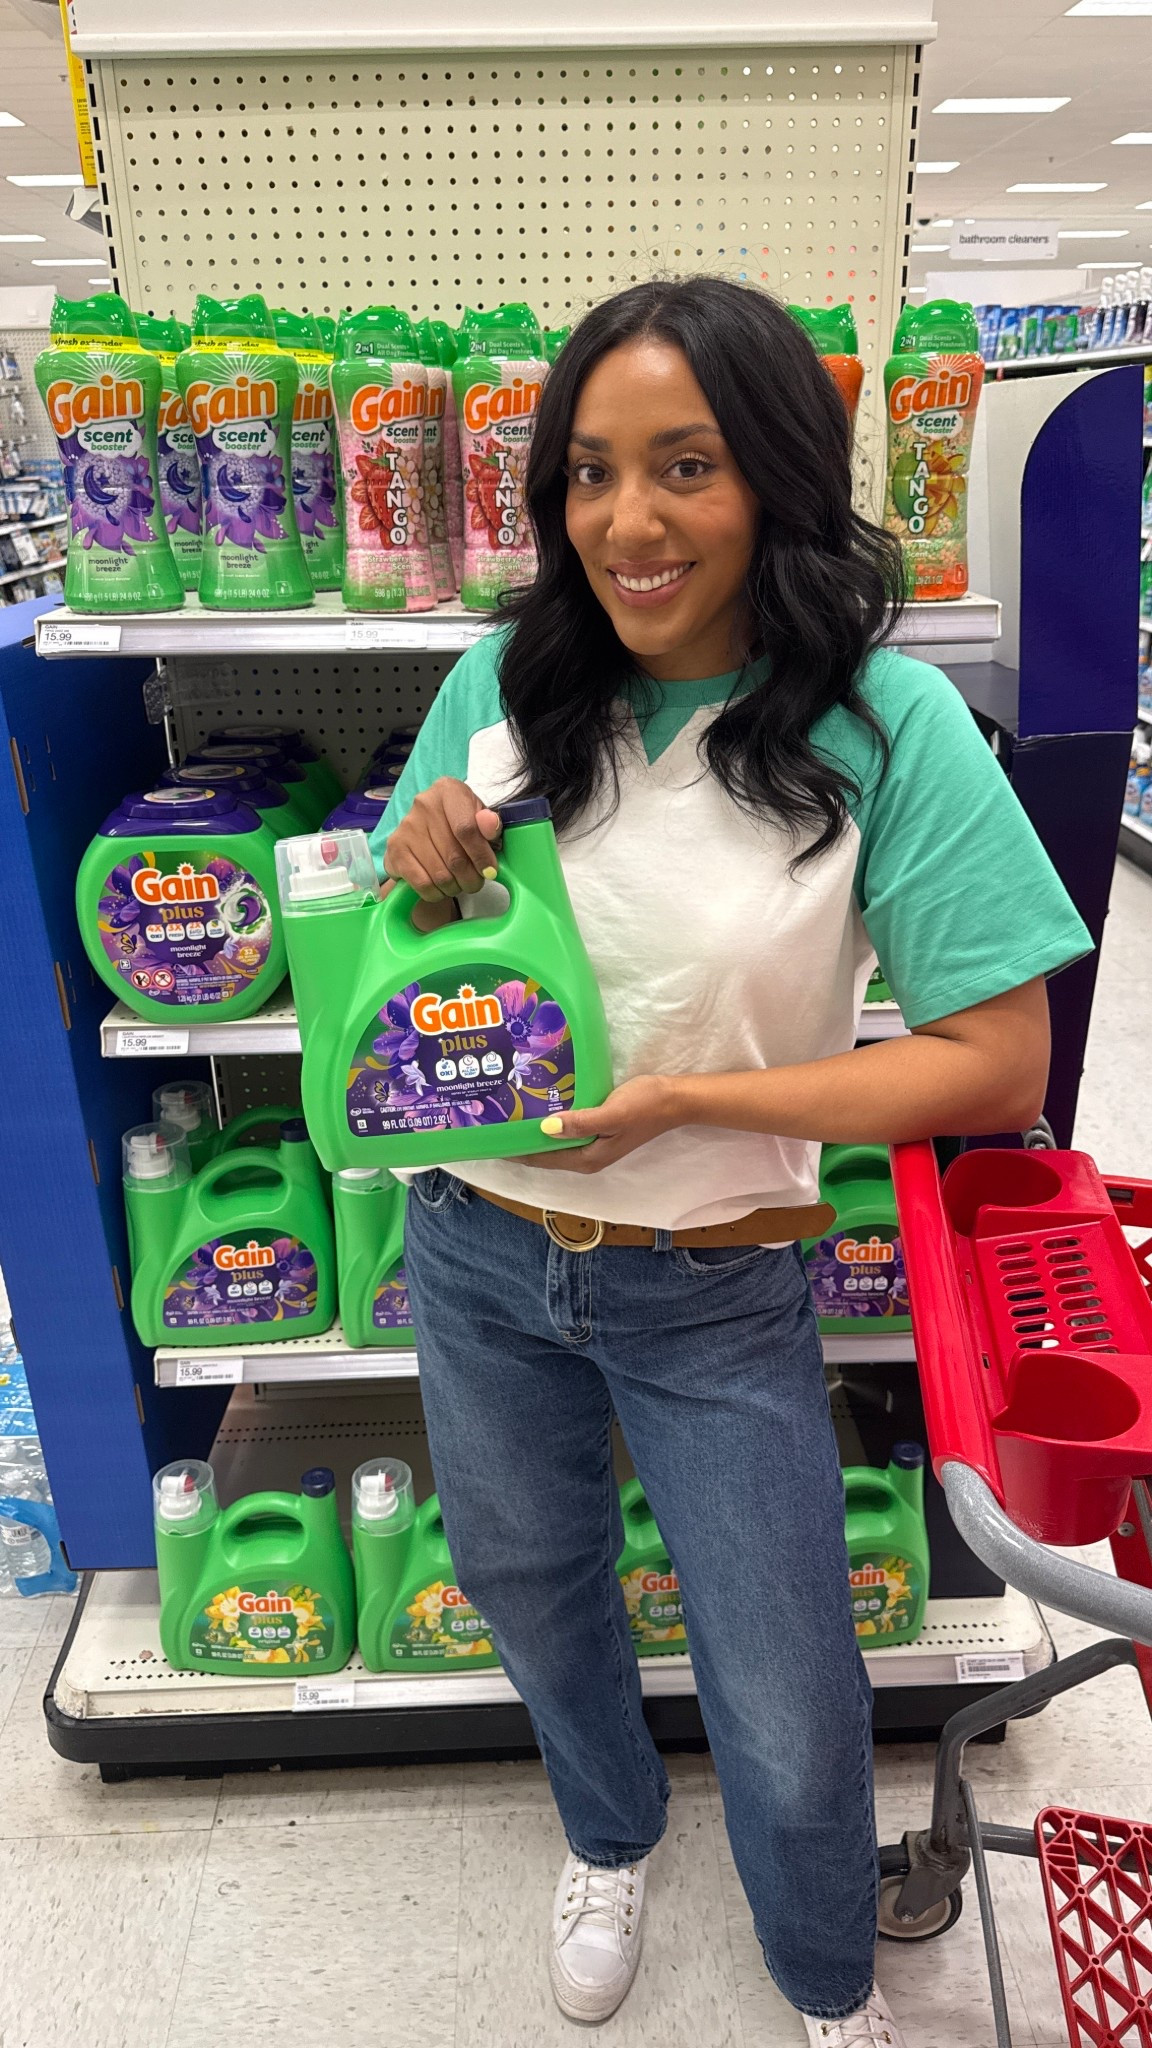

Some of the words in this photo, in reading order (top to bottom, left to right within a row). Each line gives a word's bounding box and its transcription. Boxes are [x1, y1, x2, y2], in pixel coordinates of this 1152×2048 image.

[959, 234, 1006, 244] bathroom
[1007, 234, 1049, 244] cleaners
[889, 370, 970, 422] Gain
[47, 374, 143, 437] Gain
[187, 375, 277, 435] Gain
[352, 379, 425, 432] Gain
[464, 378, 542, 431] Gain
[916, 415, 958, 427] scent
[83, 428, 133, 443] scent
[218, 429, 268, 443] scent
[386, 426, 419, 437] scent
[91, 442, 127, 451] booster
[225, 442, 261, 450] booster
[393, 436, 418, 444] booster
[909, 443, 930, 533] TANGO
[385, 452, 408, 545] TANGO
[495, 452, 517, 545] TANGO
[88, 556, 129, 567] moonlight
[220, 554, 259, 564] moonlight
[95, 565, 122, 573] breeze
[44, 632, 72, 641] 15.99
[351, 630, 379, 639] 15.99
[132, 864, 219, 904] Gain
[160, 905, 205, 923] plus
[170, 944, 207, 953] moonlight
[411, 986, 502, 1034] Gain
[122, 1038, 147, 1047] 15.99
[440, 1034, 488, 1057] plus
[436, 1082, 475, 1092] moonlight
[476, 1079, 503, 1088] breeze
[547, 1089, 560, 1098] 75
[382, 1120, 391, 1130] 99
[391, 1119, 399, 1129] FL
[398, 1119, 407, 1128] OZ
[407, 1118, 422, 1128] (3.09
[434, 1115, 447, 1125] 2.92
[447, 1115, 452, 1124] L
[214, 1241, 275, 1270] Gain
[836, 1237, 893, 1262] Gain
[231, 1270, 265, 1283] plus
[850, 1265, 881, 1276] plus
[180, 1367, 203, 1376] 15.99
[850, 1563, 886, 1586] ain
[237, 1590, 292, 1613] Gain
[251, 1614, 283, 1625] plus
[298, 1691, 320, 1701] 15.99
